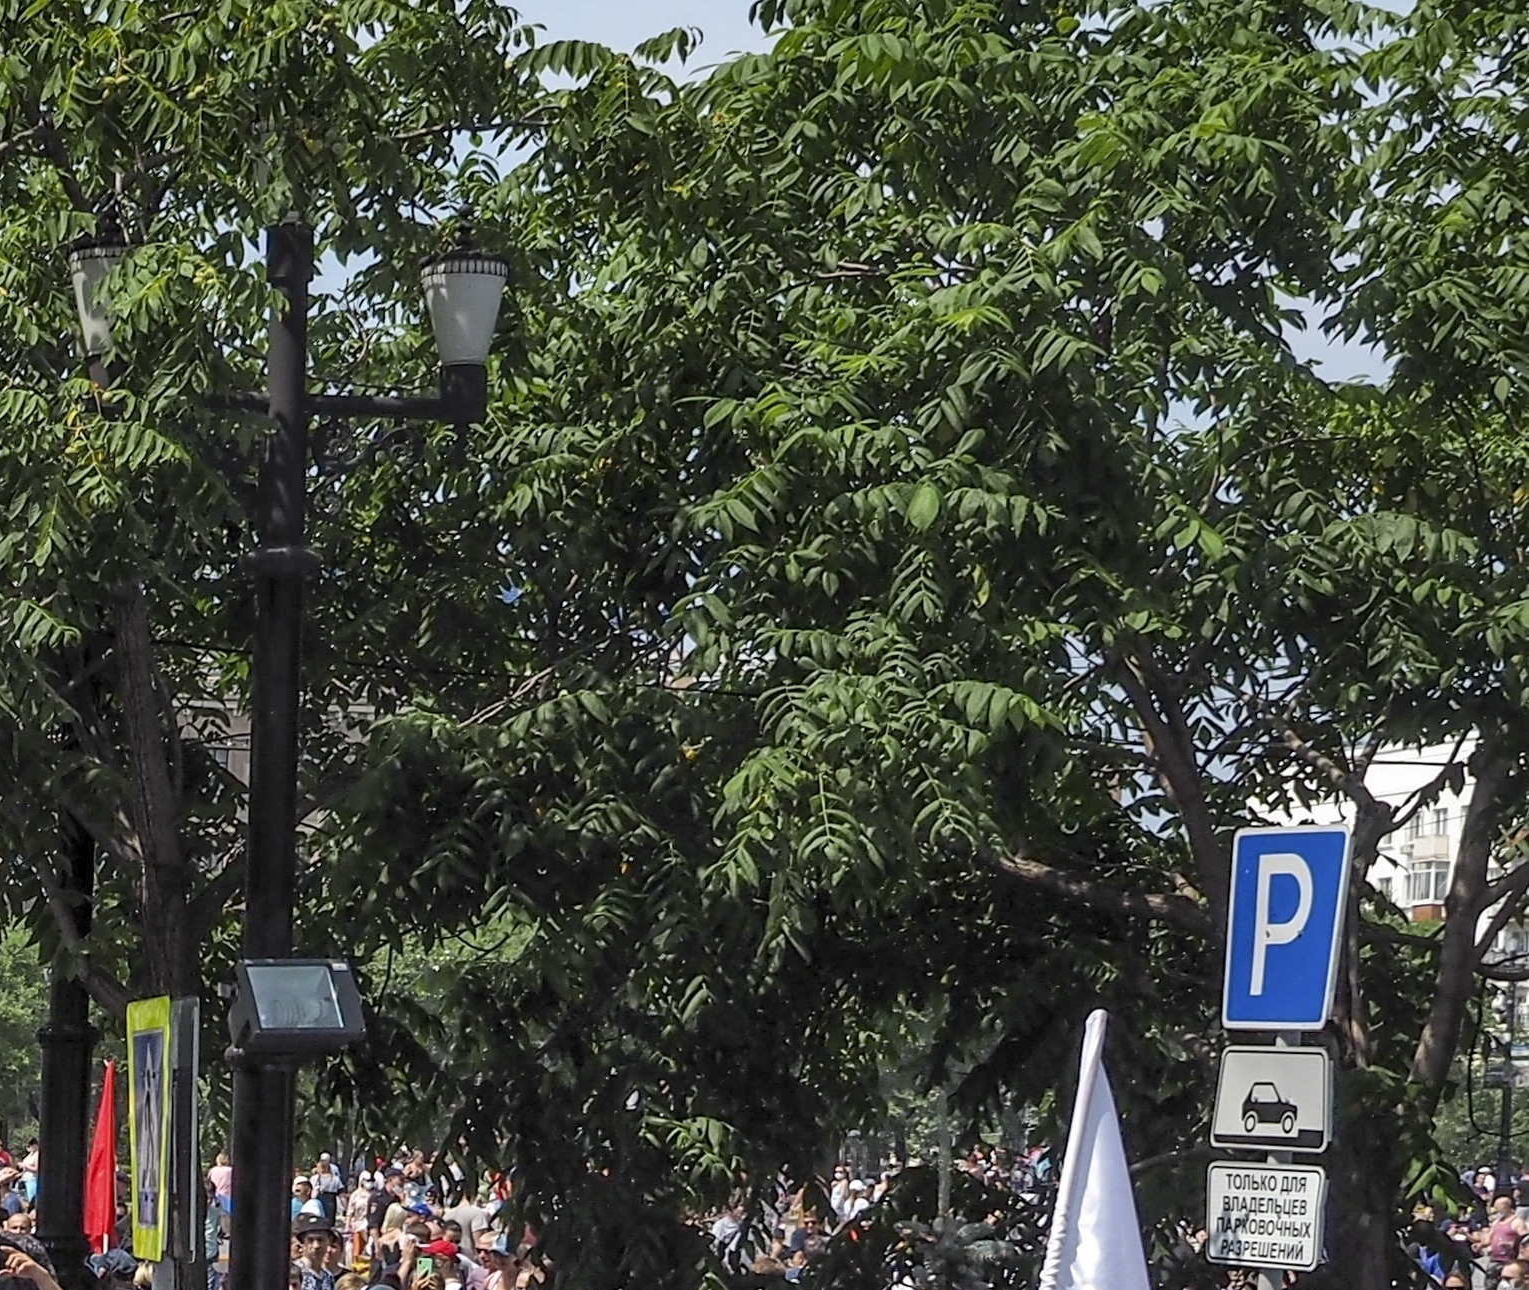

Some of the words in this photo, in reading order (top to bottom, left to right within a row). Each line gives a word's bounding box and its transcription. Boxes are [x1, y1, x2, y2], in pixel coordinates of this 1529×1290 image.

[1250, 853, 1313, 996] P
[1226, 1174, 1277, 1191] ТОЛЬКО
[1281, 1176, 1307, 1195] ДЛЯ
[1223, 1196, 1307, 1218] ВЛАДЕЛЬЦЕВ
[1217, 1217, 1311, 1238] ПАРКОВОЧНЫХ
[1221, 1239, 1304, 1260] РАЗРЕШЕНИЙ
